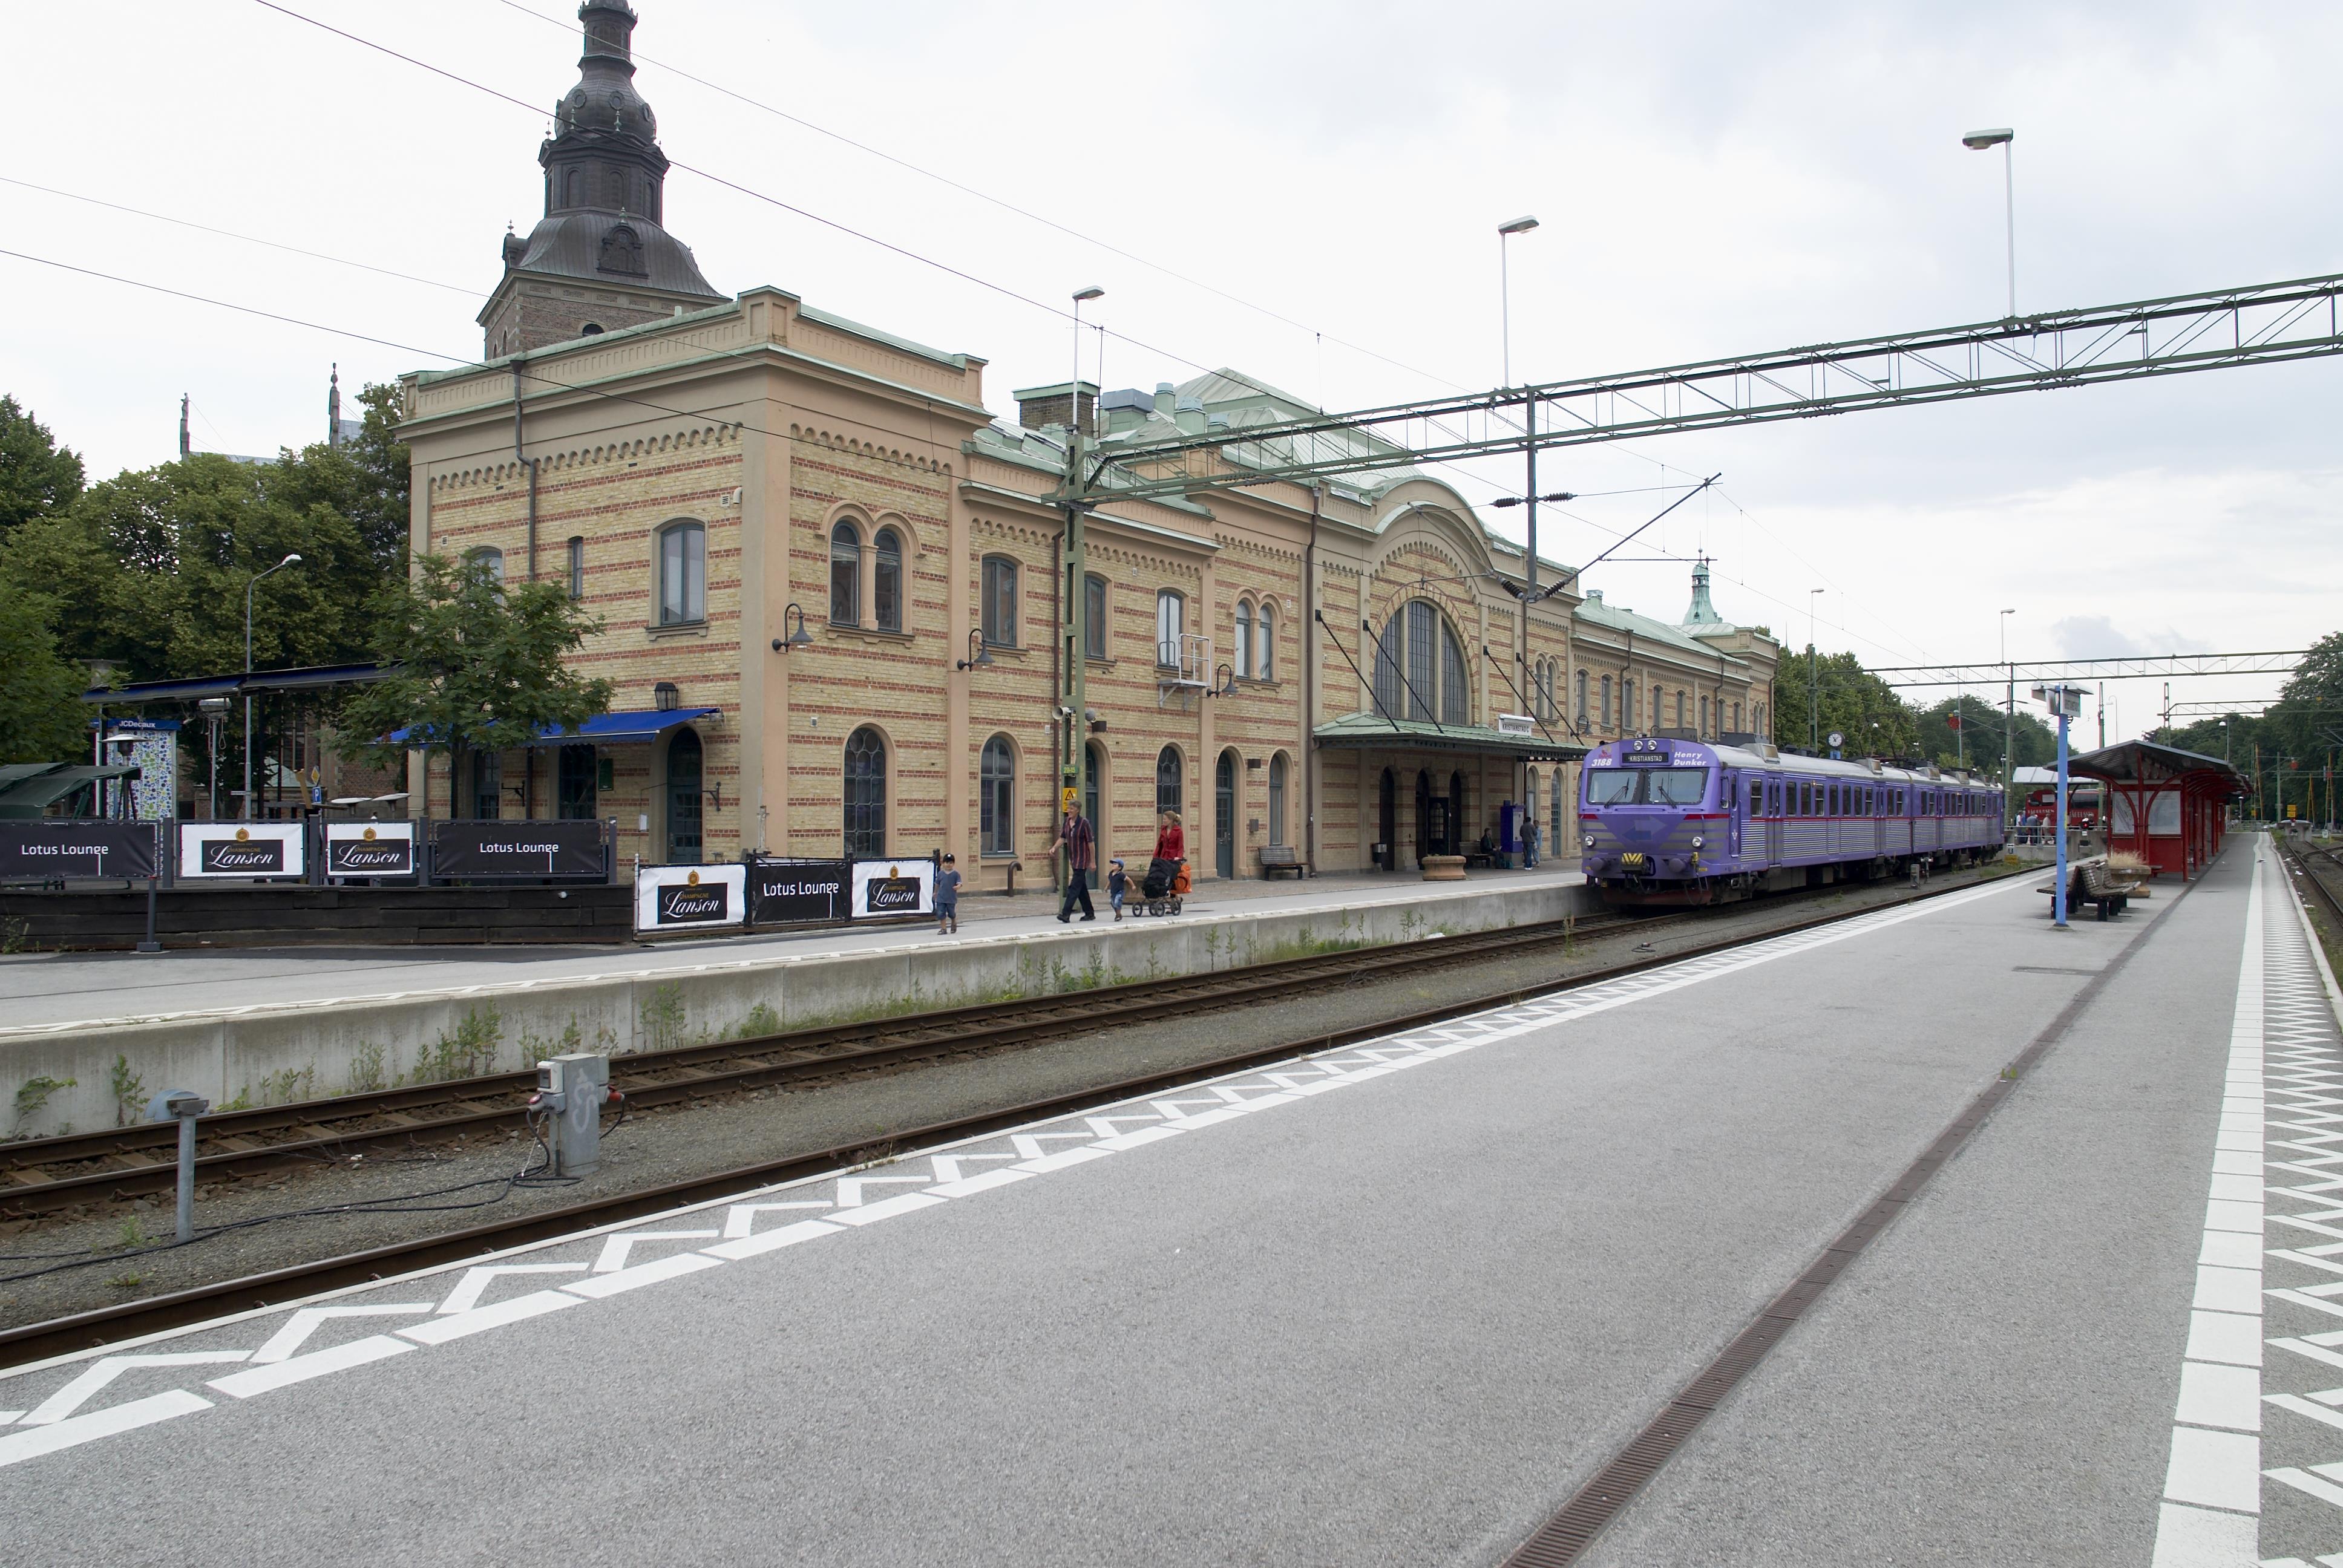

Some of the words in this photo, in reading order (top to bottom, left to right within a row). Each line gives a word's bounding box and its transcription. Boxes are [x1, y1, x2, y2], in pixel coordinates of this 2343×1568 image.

[315, 789, 319, 802] P
[21, 844, 58, 855] Lotus
[207, 845, 276, 868] Lanson
[335, 844, 402, 867] Lanson
[480, 843, 513, 852] Lotus
[763, 883, 795, 897] Lotus
[871, 883, 915, 907] Lanson
[663, 891, 721, 918] Lanson
